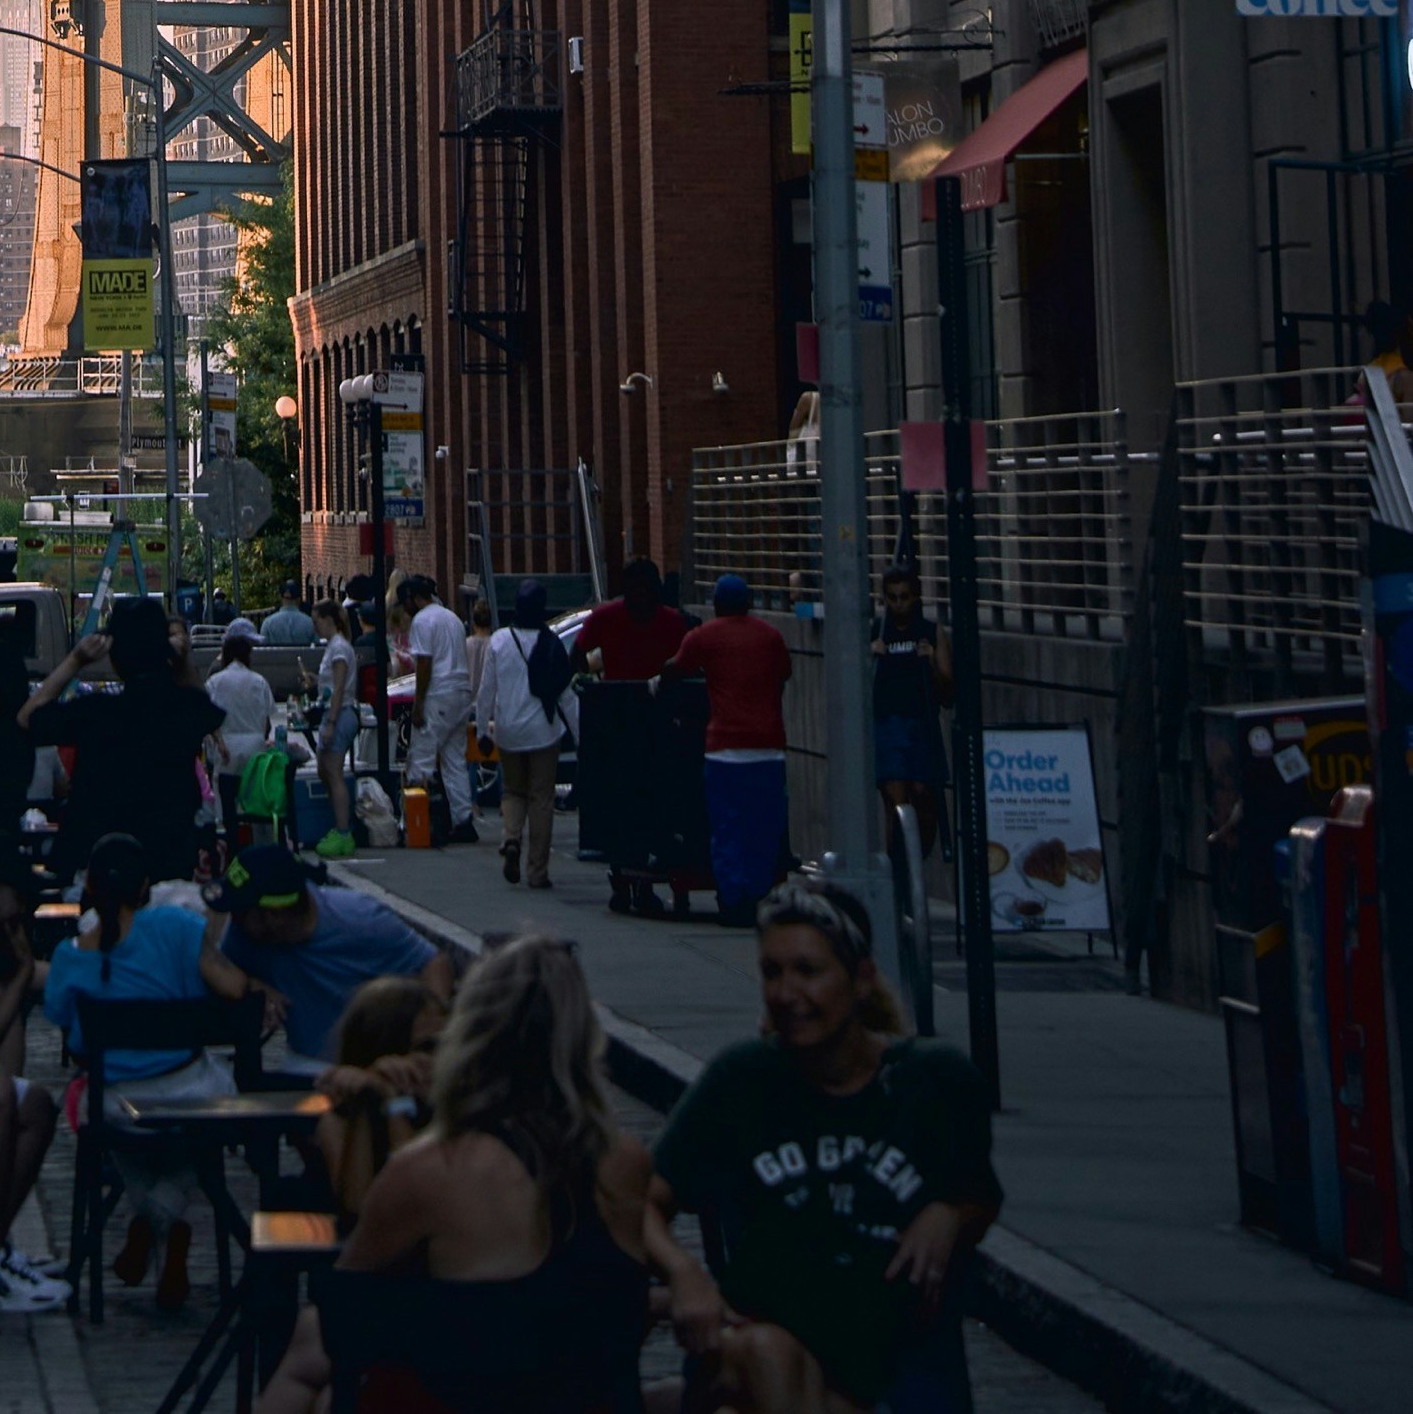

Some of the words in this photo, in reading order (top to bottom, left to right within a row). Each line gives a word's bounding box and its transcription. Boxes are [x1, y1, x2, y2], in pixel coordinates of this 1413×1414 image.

[886, 100, 934, 127] ALON
[888, 117, 944, 147] UMBO
[91, 272, 146, 293] MADE
[131, 436, 165, 449] Plymout
[985, 749, 1058, 771] Order
[988, 772, 1070, 792] Ahead
[752, 1140, 809, 1188] GO
